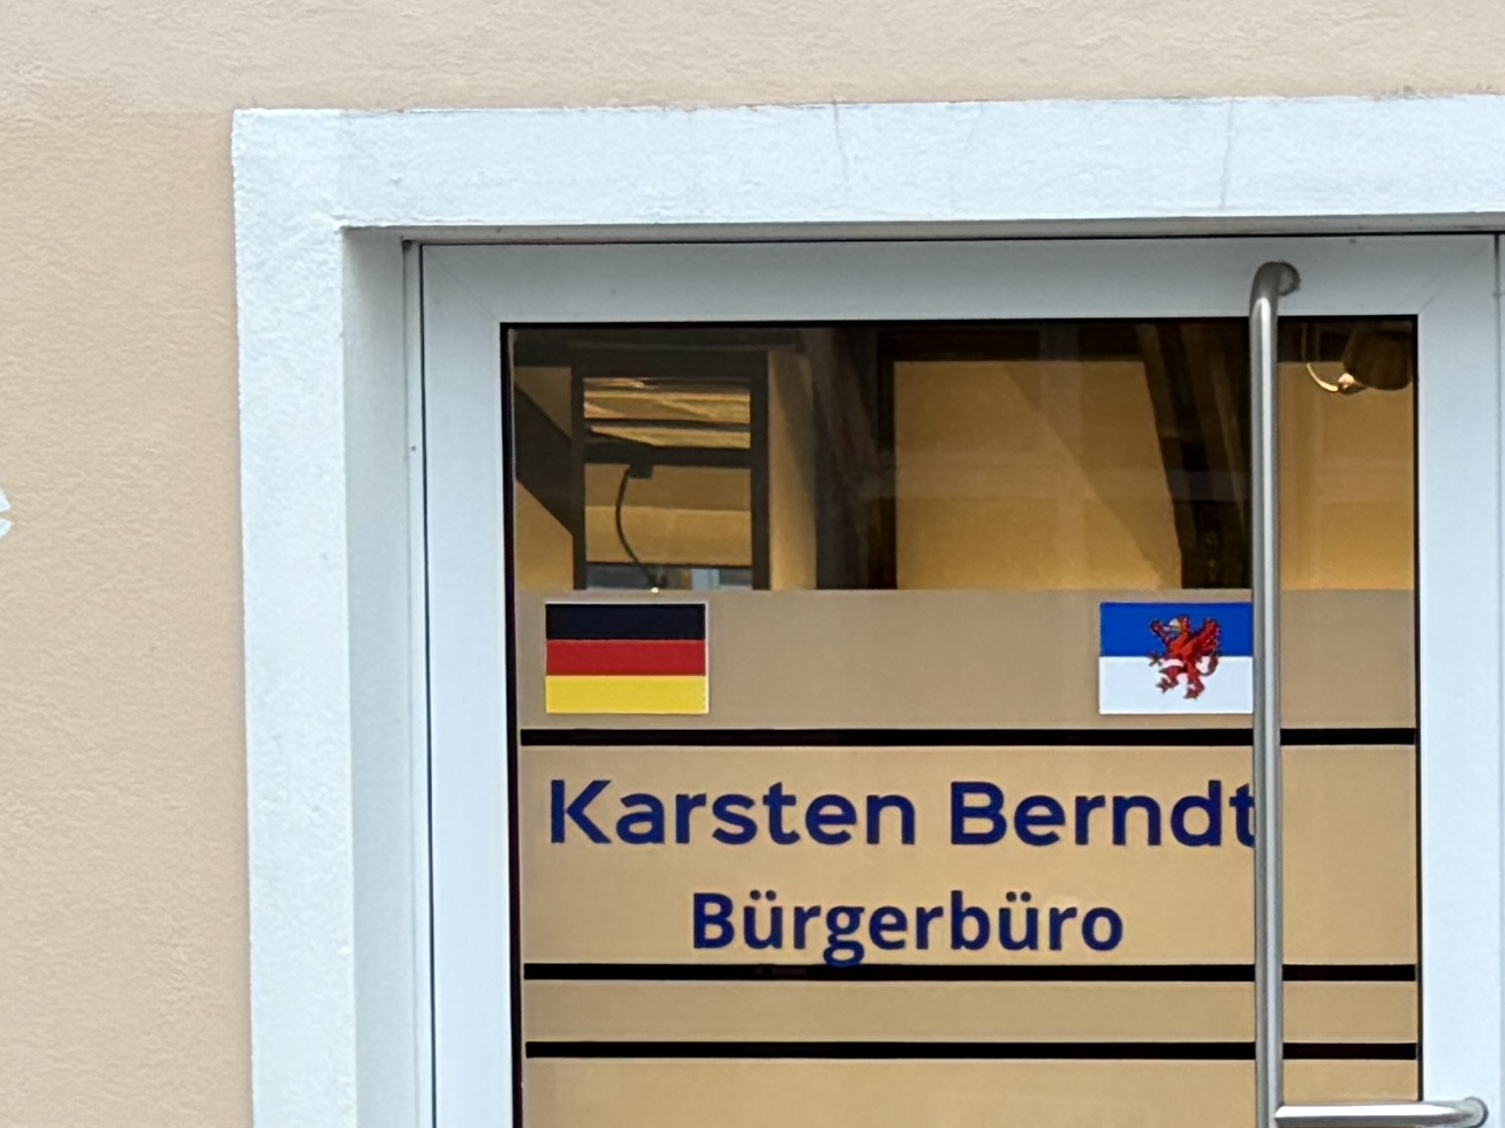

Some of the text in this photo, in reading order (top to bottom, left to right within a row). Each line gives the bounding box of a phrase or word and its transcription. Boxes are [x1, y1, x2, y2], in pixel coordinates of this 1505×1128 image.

[552, 779, 1257, 848] Karsten Berndt
[693, 891, 1123, 967] Bürgerbüro
